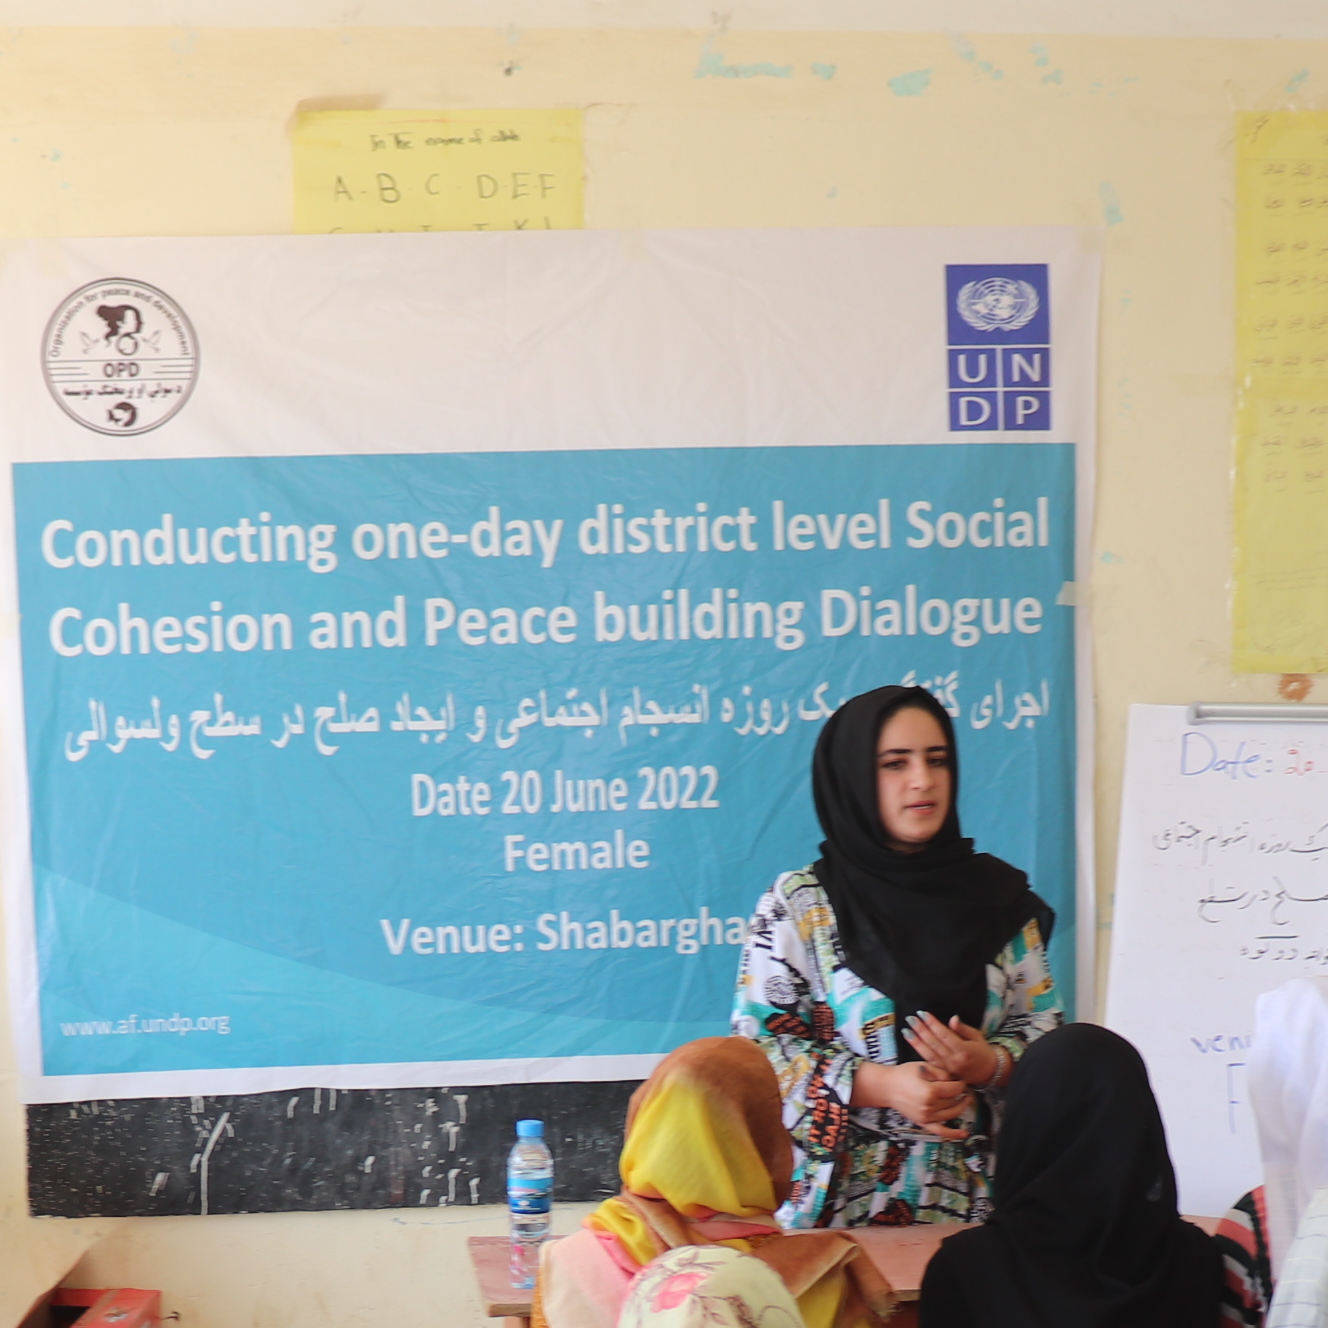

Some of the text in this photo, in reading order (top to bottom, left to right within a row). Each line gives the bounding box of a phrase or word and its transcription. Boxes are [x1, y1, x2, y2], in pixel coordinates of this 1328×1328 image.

[102, 361, 141, 378] OPD
[41, 496, 1049, 574] Conducting one-day district level Social
[49, 584, 1043, 658] Cohesion and Peace building Dialogue
[188, 692, 262, 760] سطح
[270, 703, 305, 749] در
[313, 690, 381, 757] صلح
[390, 693, 456, 744] ایجاد
[466, 705, 487, 743] و
[618, 683, 710, 746] انسجام
[720, 685, 790, 736] روزه
[1180, 732, 1273, 780] Date:
[411, 765, 720, 817] Date 20 June 2022
[504, 828, 650, 872] Female
[379, 906, 748, 956] Venue: Shabargha
[59, 1012, 231, 1037] www.af.undp.org
